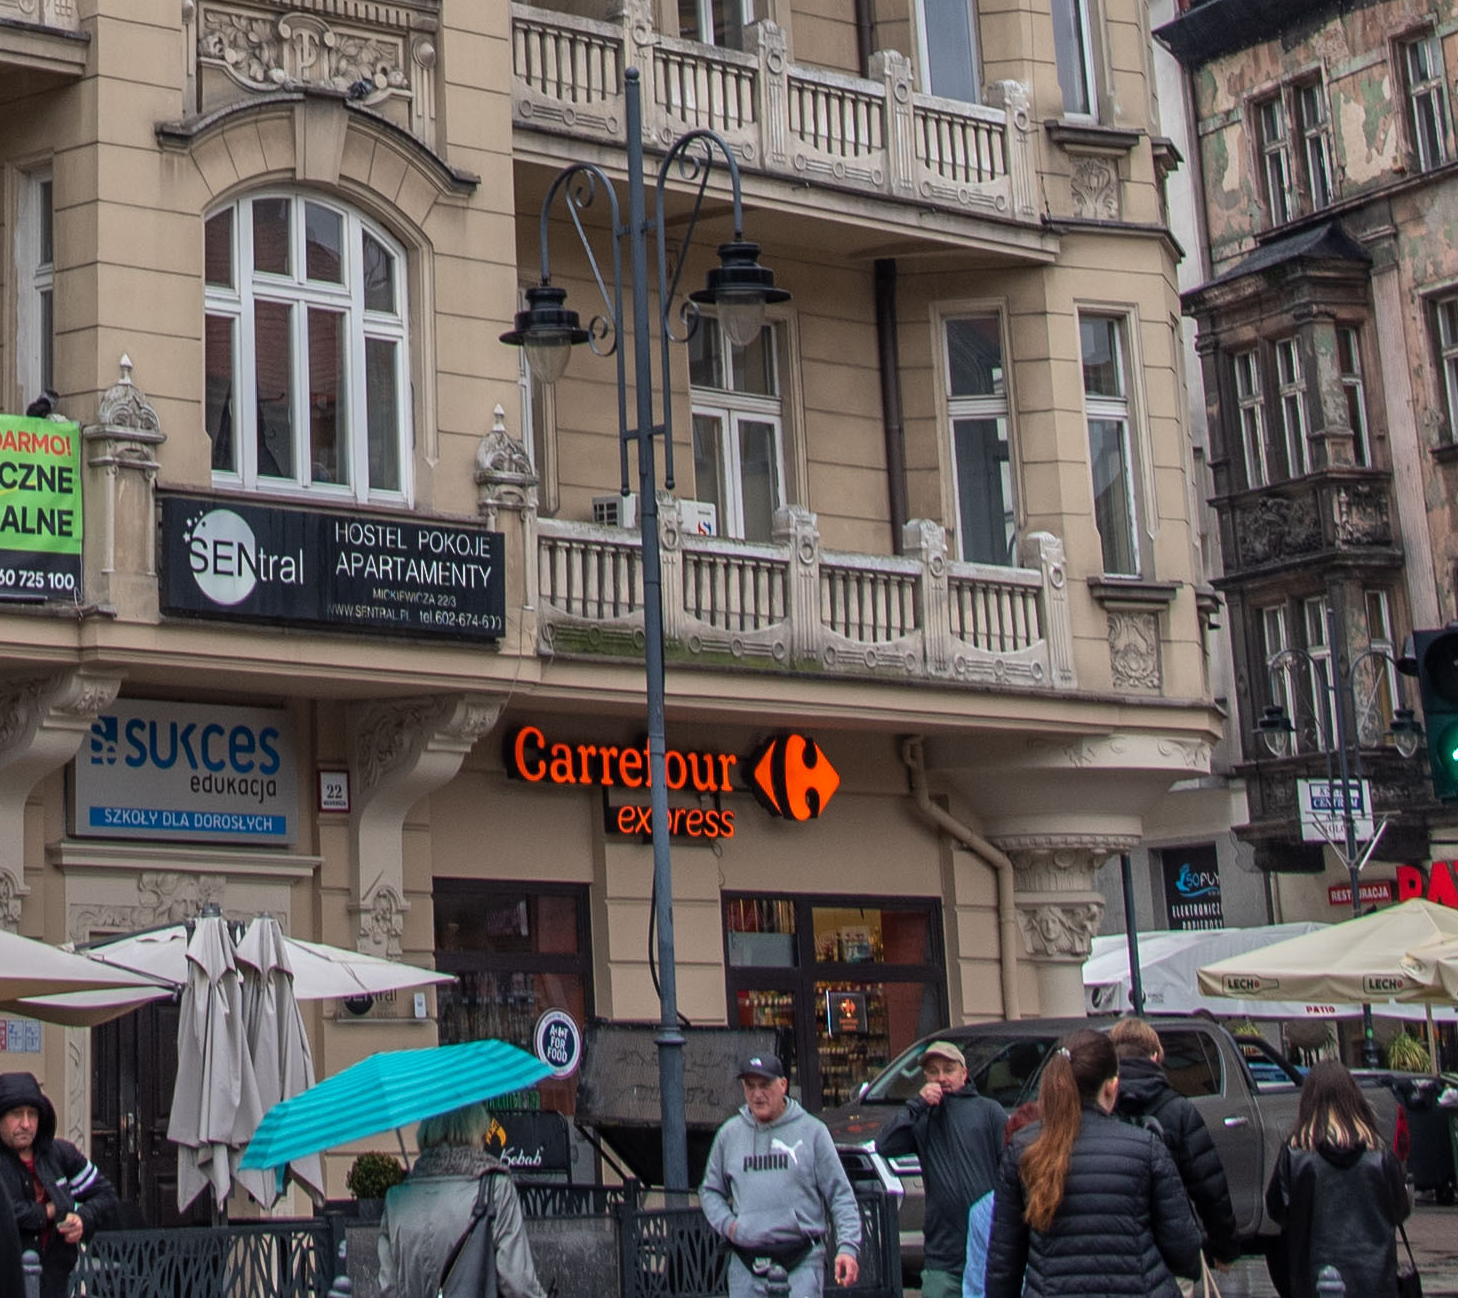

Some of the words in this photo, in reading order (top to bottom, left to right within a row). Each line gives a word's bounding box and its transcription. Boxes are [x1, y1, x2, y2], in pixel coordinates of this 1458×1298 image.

[335, 521, 407, 550] HOSTEL
[418, 529, 491, 558] POKOJE
[189, 537, 304, 584] SENtral
[19, 570, 44, 588] 725
[47, 572, 74, 590] 100
[335, 552, 492, 589] APARTAMENTY
[514, 726, 737, 792] Carreour
[190, 775, 277, 803] edukacja
[327, 784, 342, 799] 22
[104, 808, 158, 826] SZKOŁY
[163, 812, 189, 827] DLA
[195, 813, 272, 831] DOROSŁYCH
[617, 805, 735, 838] exress
[1172, 903, 1221, 919] ELEKTRONICZ
[1228, 979, 1254, 990] LECH
[1368, 979, 1396, 990] LECH
[551, 1036, 565, 1050] FOR
[547, 1046, 568, 1063] FOOD
[500, 1147, 542, 1166] Kebab
[743, 1154, 788, 1172] PUMA
